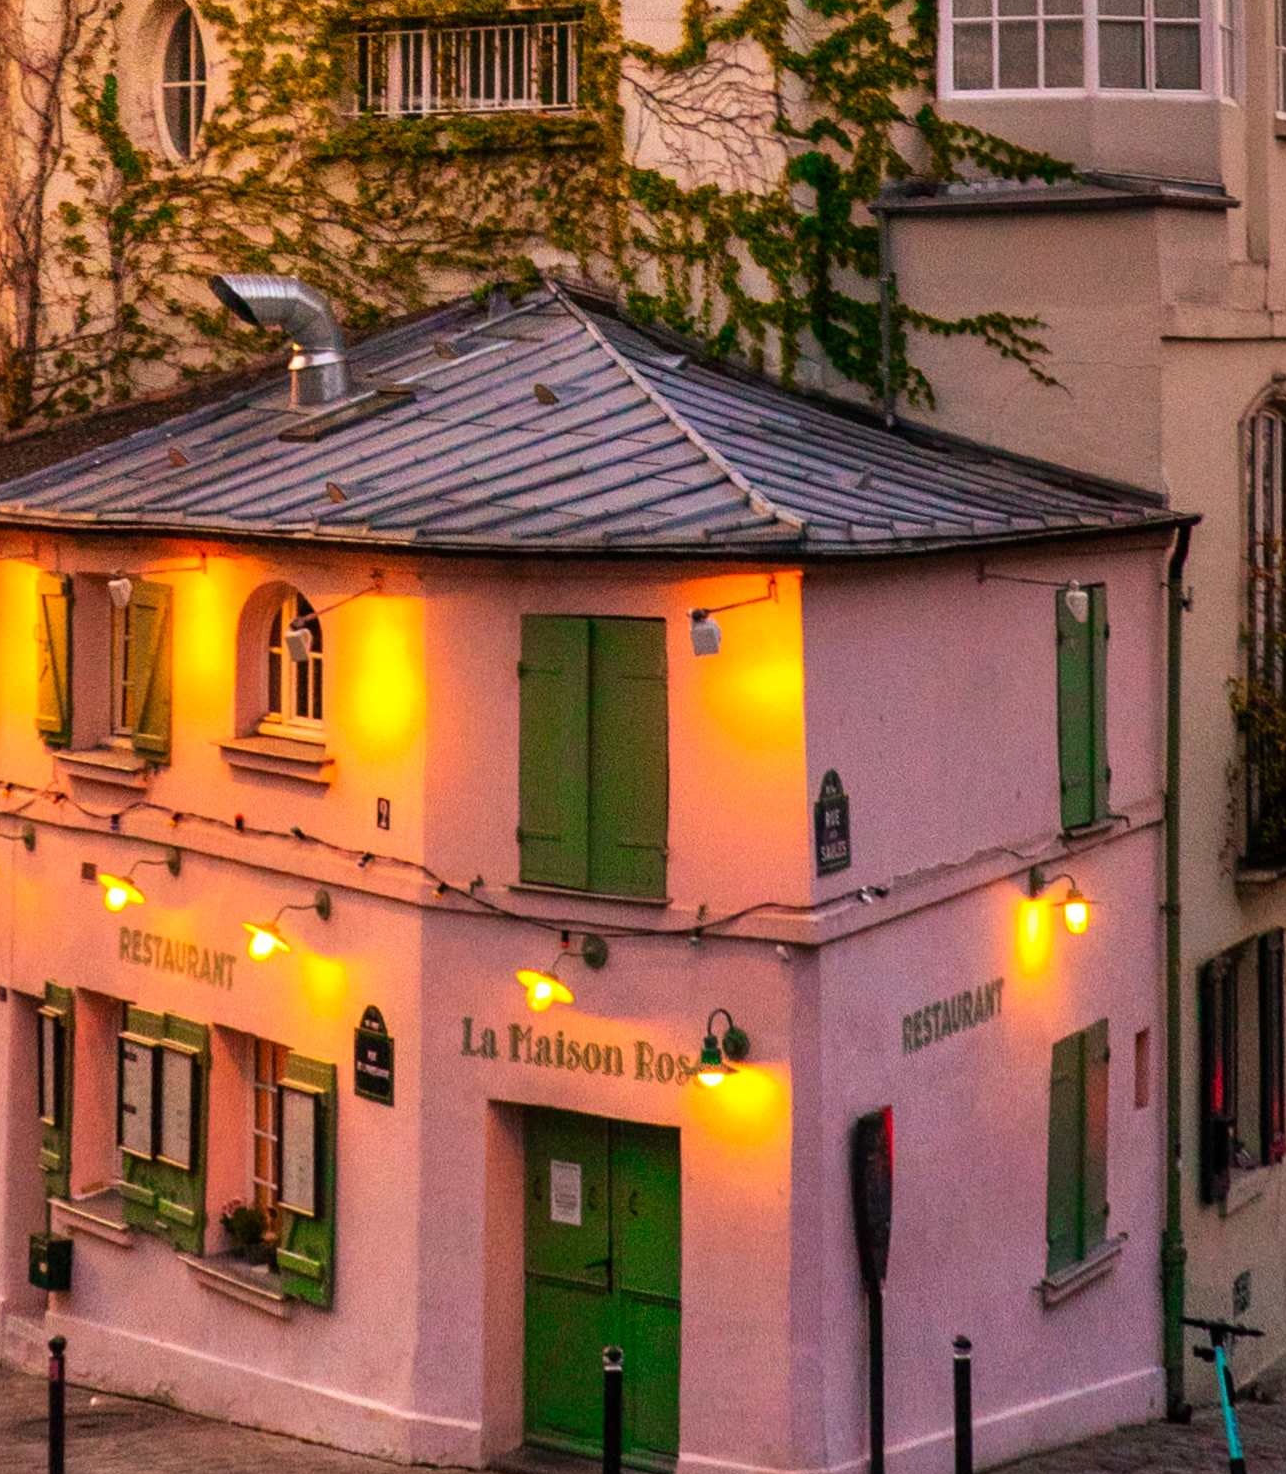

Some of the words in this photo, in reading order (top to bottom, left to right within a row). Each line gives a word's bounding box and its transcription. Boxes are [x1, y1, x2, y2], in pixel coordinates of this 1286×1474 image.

[118, 925, 237, 991] RESTAURANT
[901, 976, 1005, 1055] RESTAURANT
[461, 1016, 498, 1060] La
[508, 1021, 625, 1077] Maison
[633, 1039, 693, 1087] Ros
